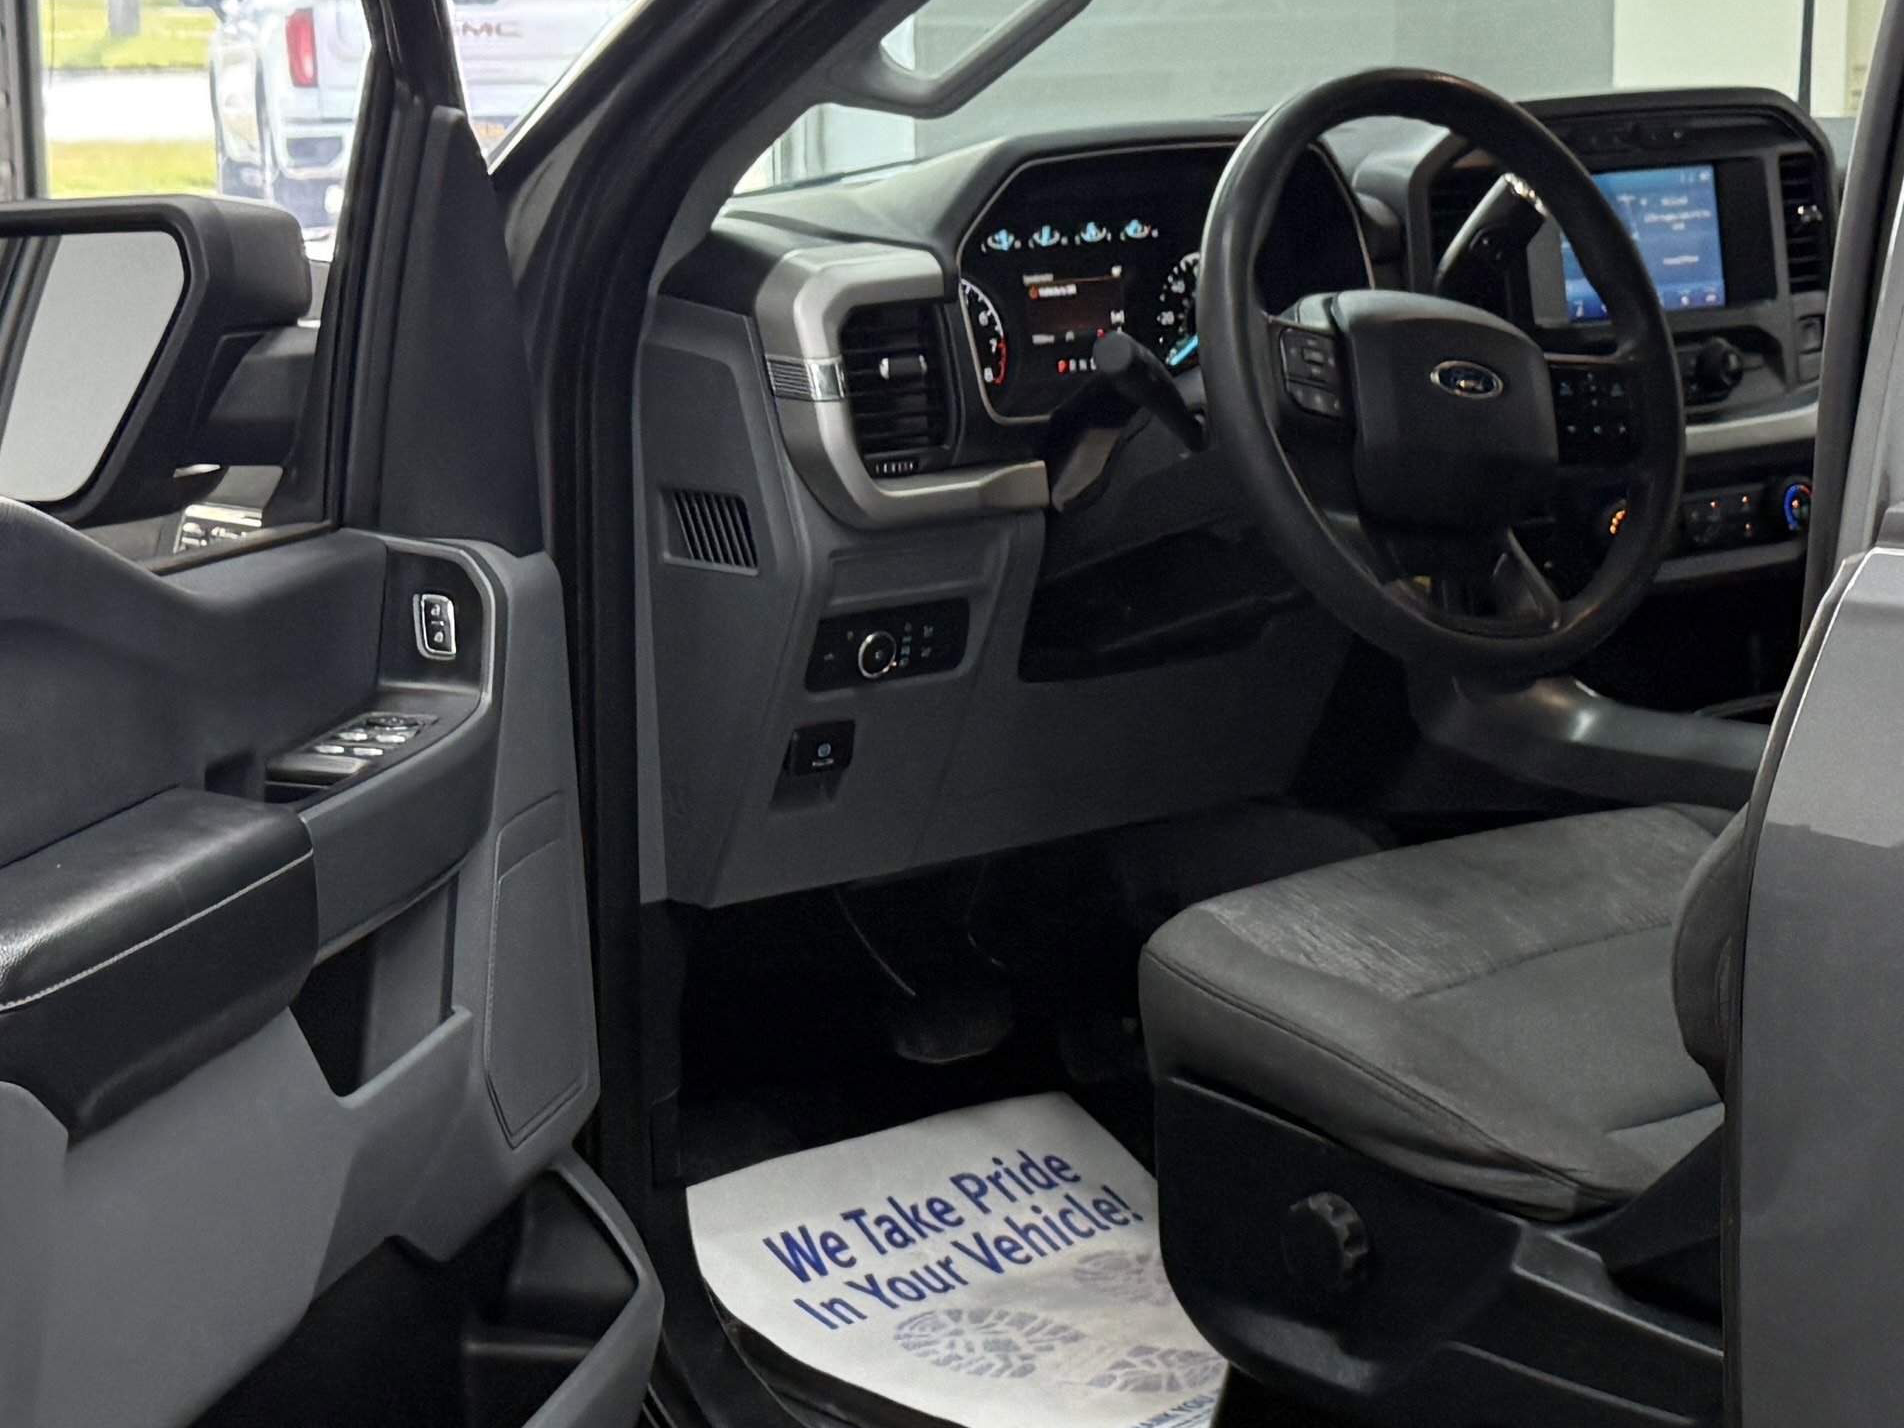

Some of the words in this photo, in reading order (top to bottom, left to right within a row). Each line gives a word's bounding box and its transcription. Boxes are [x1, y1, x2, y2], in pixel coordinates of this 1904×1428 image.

[455, 21, 523, 38] MC
[763, 1223, 858, 1284] We
[840, 1195, 964, 1256] Take
[949, 1149, 1083, 1212] Pride
[794, 1294, 868, 1331] In
[844, 1255, 968, 1311] Your
[953, 1184, 1144, 1276] Vehicle!
